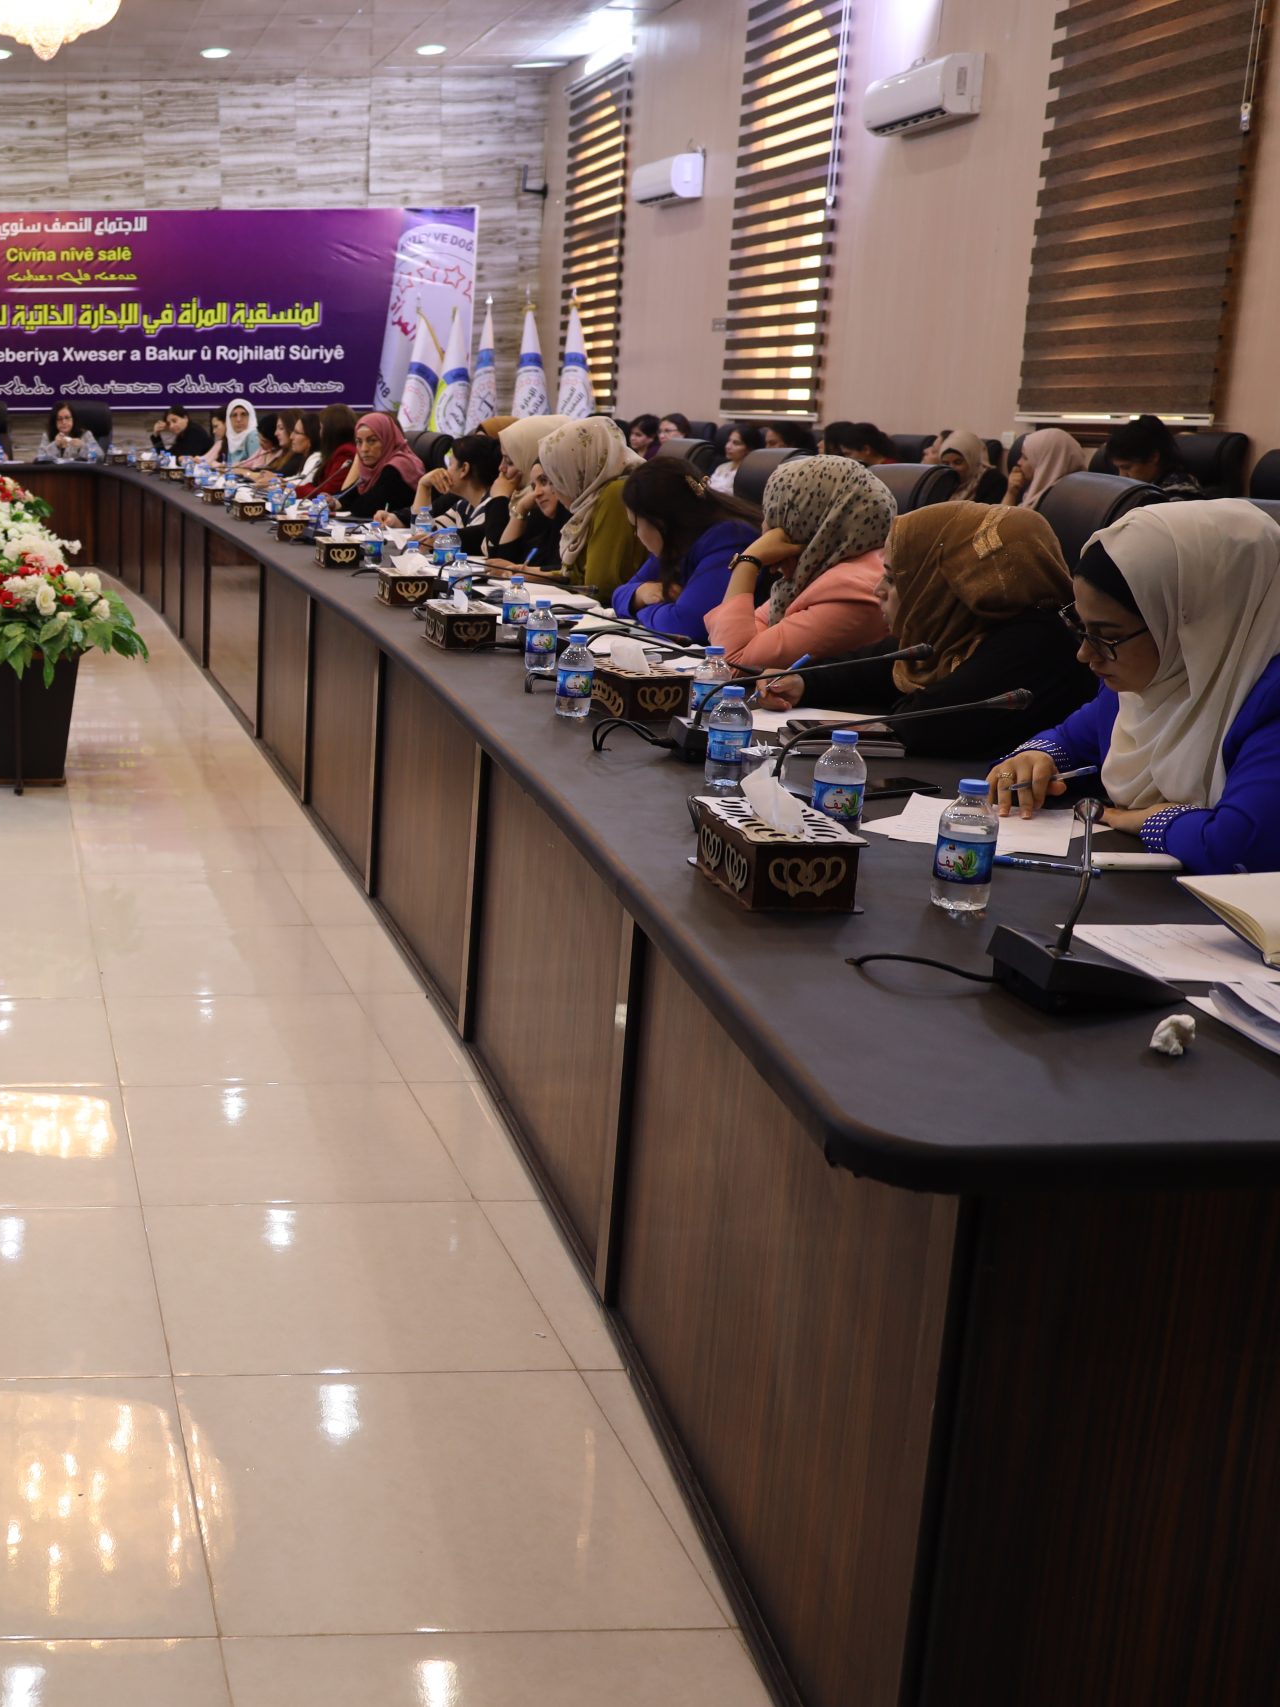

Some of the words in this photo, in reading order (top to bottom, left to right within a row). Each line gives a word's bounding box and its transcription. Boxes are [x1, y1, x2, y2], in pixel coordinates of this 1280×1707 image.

[44, 217, 92, 233] النصف
[94, 216, 148, 236] الاجتماع
[60, 246, 94, 262] nîvê
[98, 246, 132, 261] salê
[11, 303, 74, 332] الذاتية
[142, 303, 173, 335] في
[177, 297, 228, 330] المرأة
[231, 301, 320, 330] لمنسقية
[62, 347, 126, 362] Xweser
[130, 350, 141, 361] a
[145, 346, 197, 361] Bakur
[200, 346, 211, 360] û
[289, 345, 345, 363] Sûriyê
